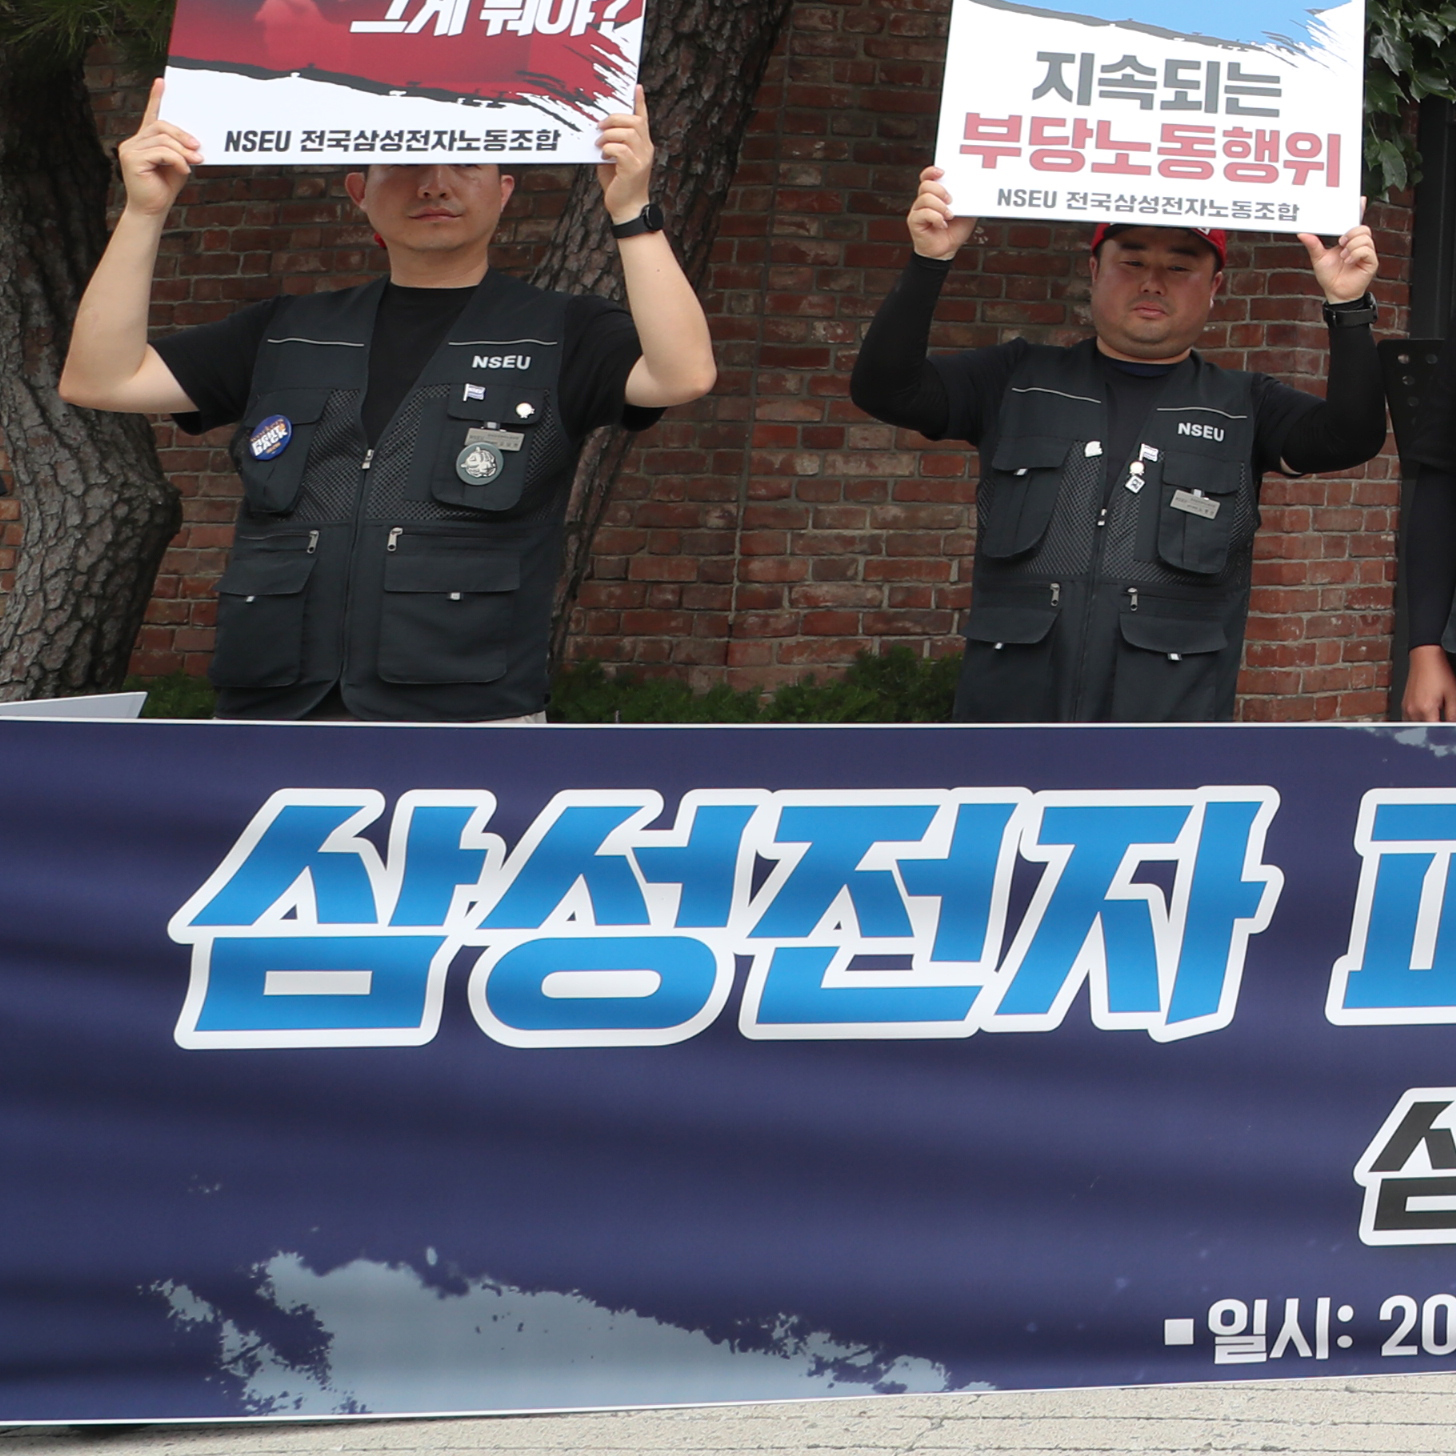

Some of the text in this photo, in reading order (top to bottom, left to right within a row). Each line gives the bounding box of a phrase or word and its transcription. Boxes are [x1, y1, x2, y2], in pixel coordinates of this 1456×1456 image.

[1032, 51, 1283, 117] 지속되는
[224, 129, 561, 152] NSEU 전국삼성전자노동조합
[959, 112, 1342, 188] 부당노동행위
[997, 188, 1300, 222] NSEU 전국삼성전자노동조합
[472, 355, 531, 370] NSEU
[1178, 422, 1225, 442] NSEU
[168, 787, 1284, 1049] 삼성전자
[1207, 1295, 1353, 1364] 일시:
